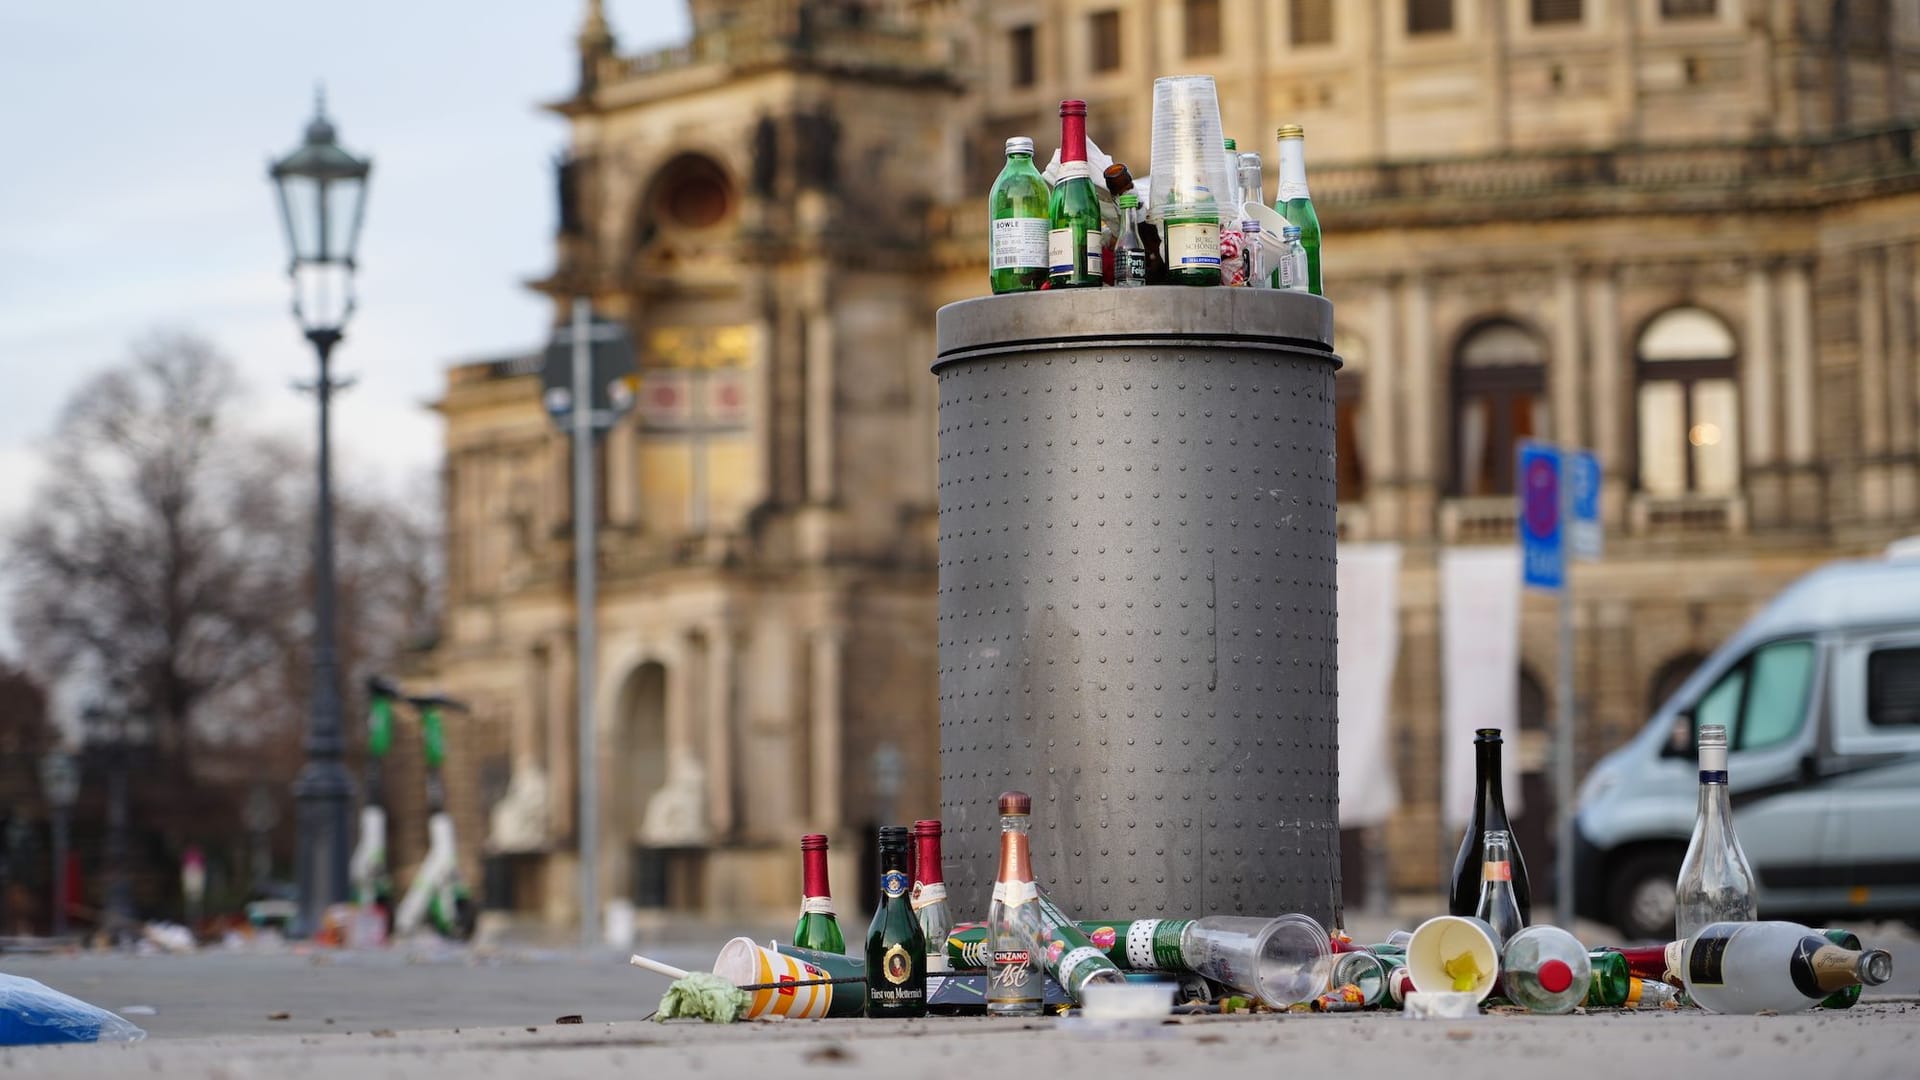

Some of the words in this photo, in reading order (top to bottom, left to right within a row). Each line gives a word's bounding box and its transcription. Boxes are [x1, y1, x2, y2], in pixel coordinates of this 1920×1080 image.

[996, 221, 1019, 229] BOWLE
[994, 952, 1028, 961] CINZANO
[884, 990, 895, 999] von
